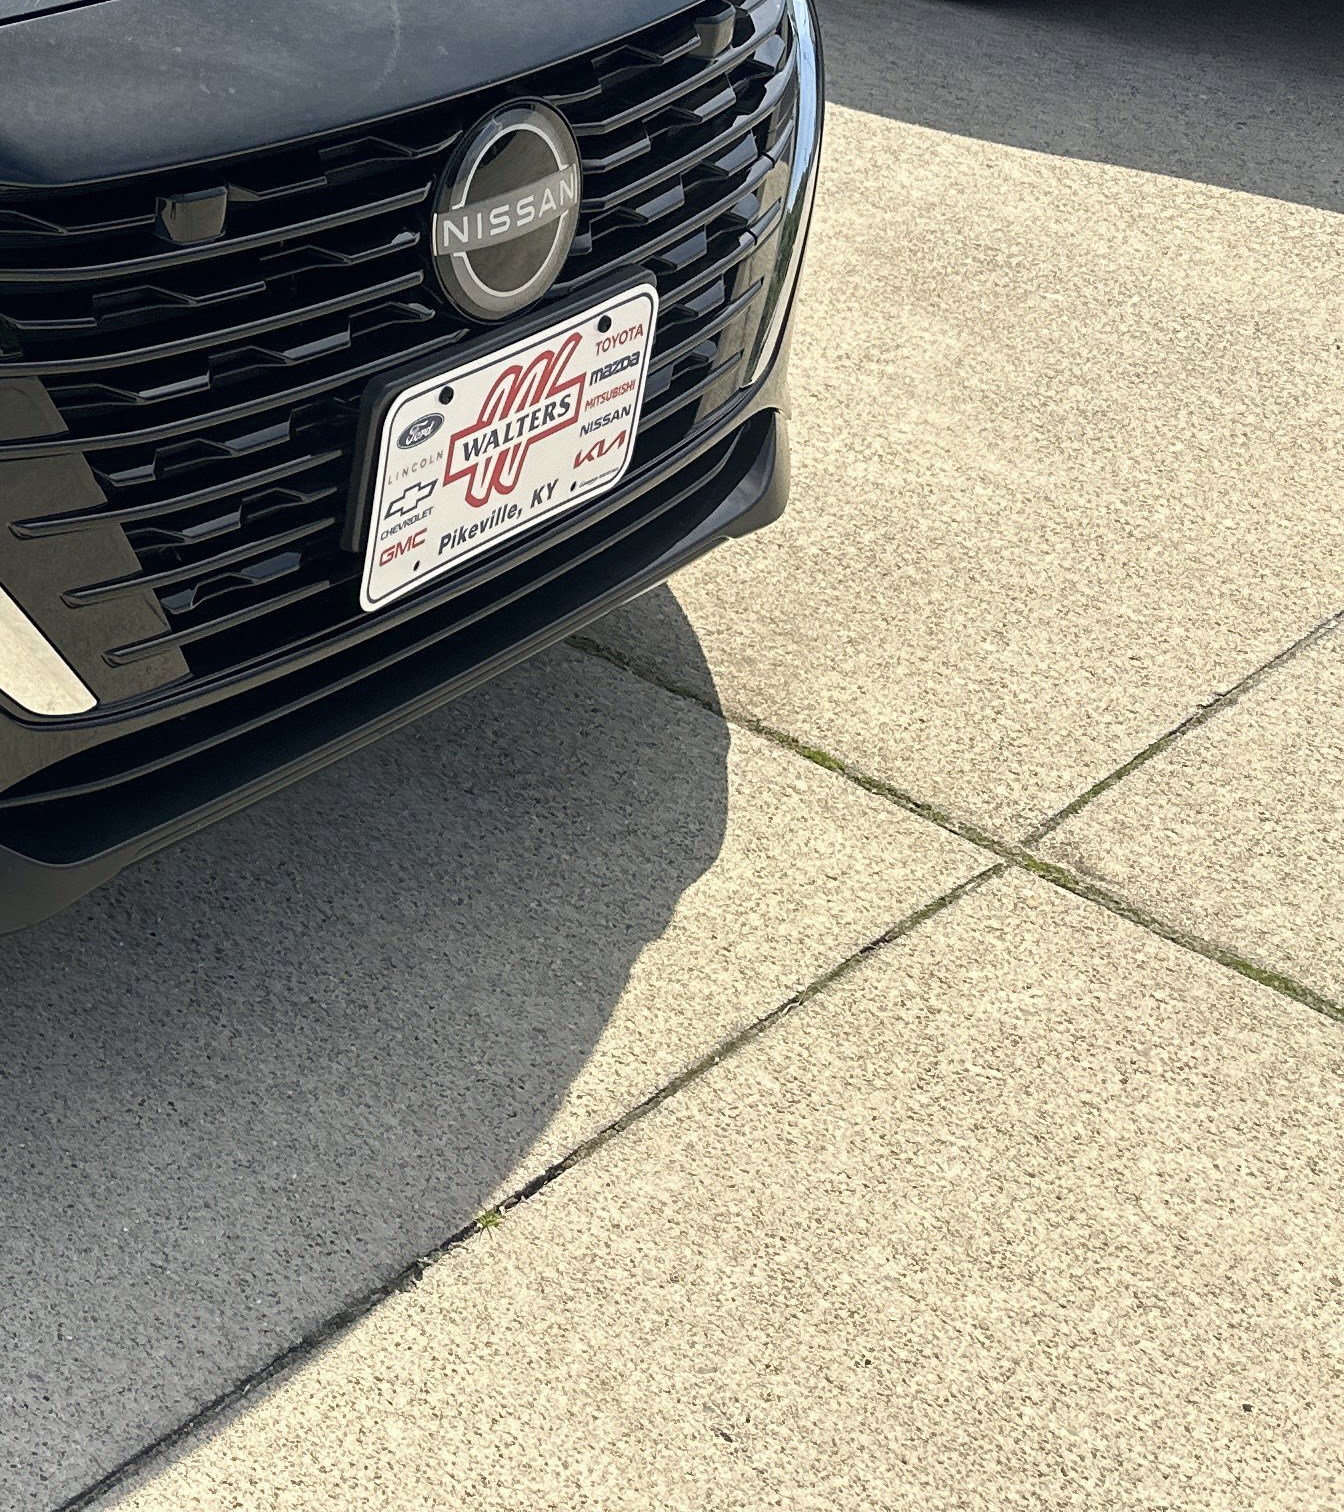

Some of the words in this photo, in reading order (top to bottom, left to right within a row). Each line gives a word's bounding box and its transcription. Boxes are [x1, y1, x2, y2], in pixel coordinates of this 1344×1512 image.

[443, 173, 574, 247] NISSAN
[595, 323, 644, 356] TOYOTA
[584, 379, 636, 412] MITSUBISHI
[405, 420, 436, 446] Ford
[463, 393, 571, 462] WALTERS
[579, 403, 632, 438] NISSAN
[388, 450, 444, 486] LINCOLN
[380, 506, 434, 541] CHEVROLET
[438, 503, 523, 556] Pikeville,
[530, 478, 559, 509] KY
[379, 527, 428, 567] GMC
